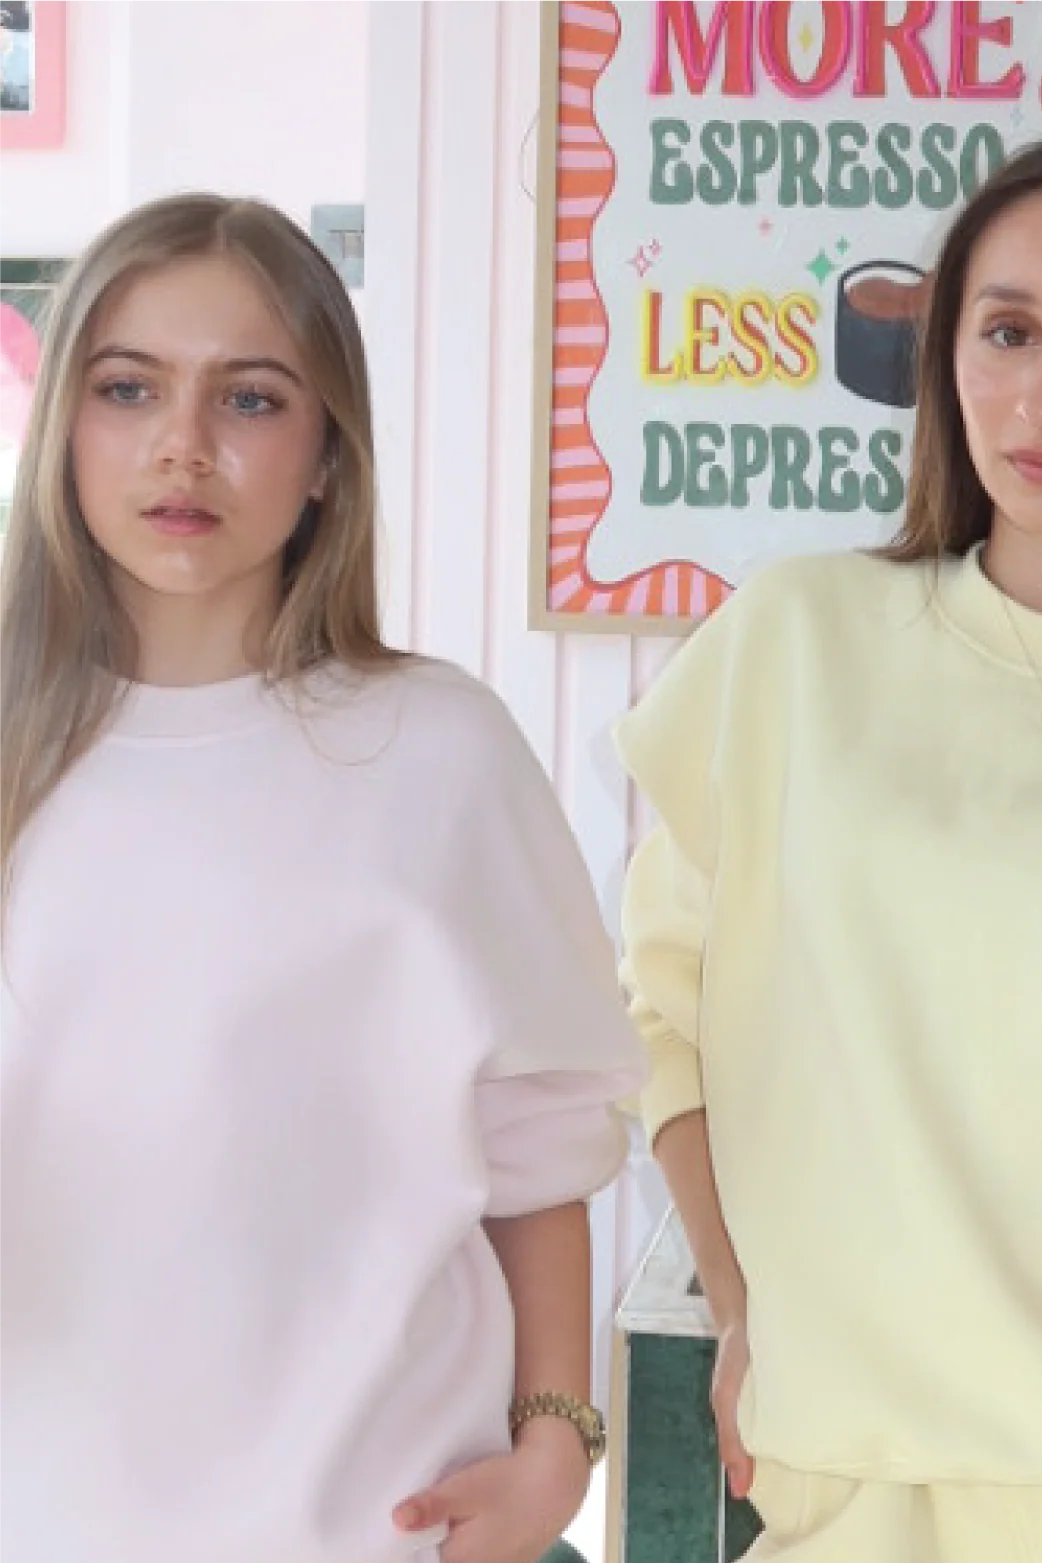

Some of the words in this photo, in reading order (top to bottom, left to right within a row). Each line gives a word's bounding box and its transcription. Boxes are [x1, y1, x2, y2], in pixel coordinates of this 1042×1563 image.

[648, 0, 1027, 100] MORE
[649, 117, 1005, 209] ESPRESSO
[640, 288, 820, 388] LESS
[640, 420, 904, 513] DEPRES
